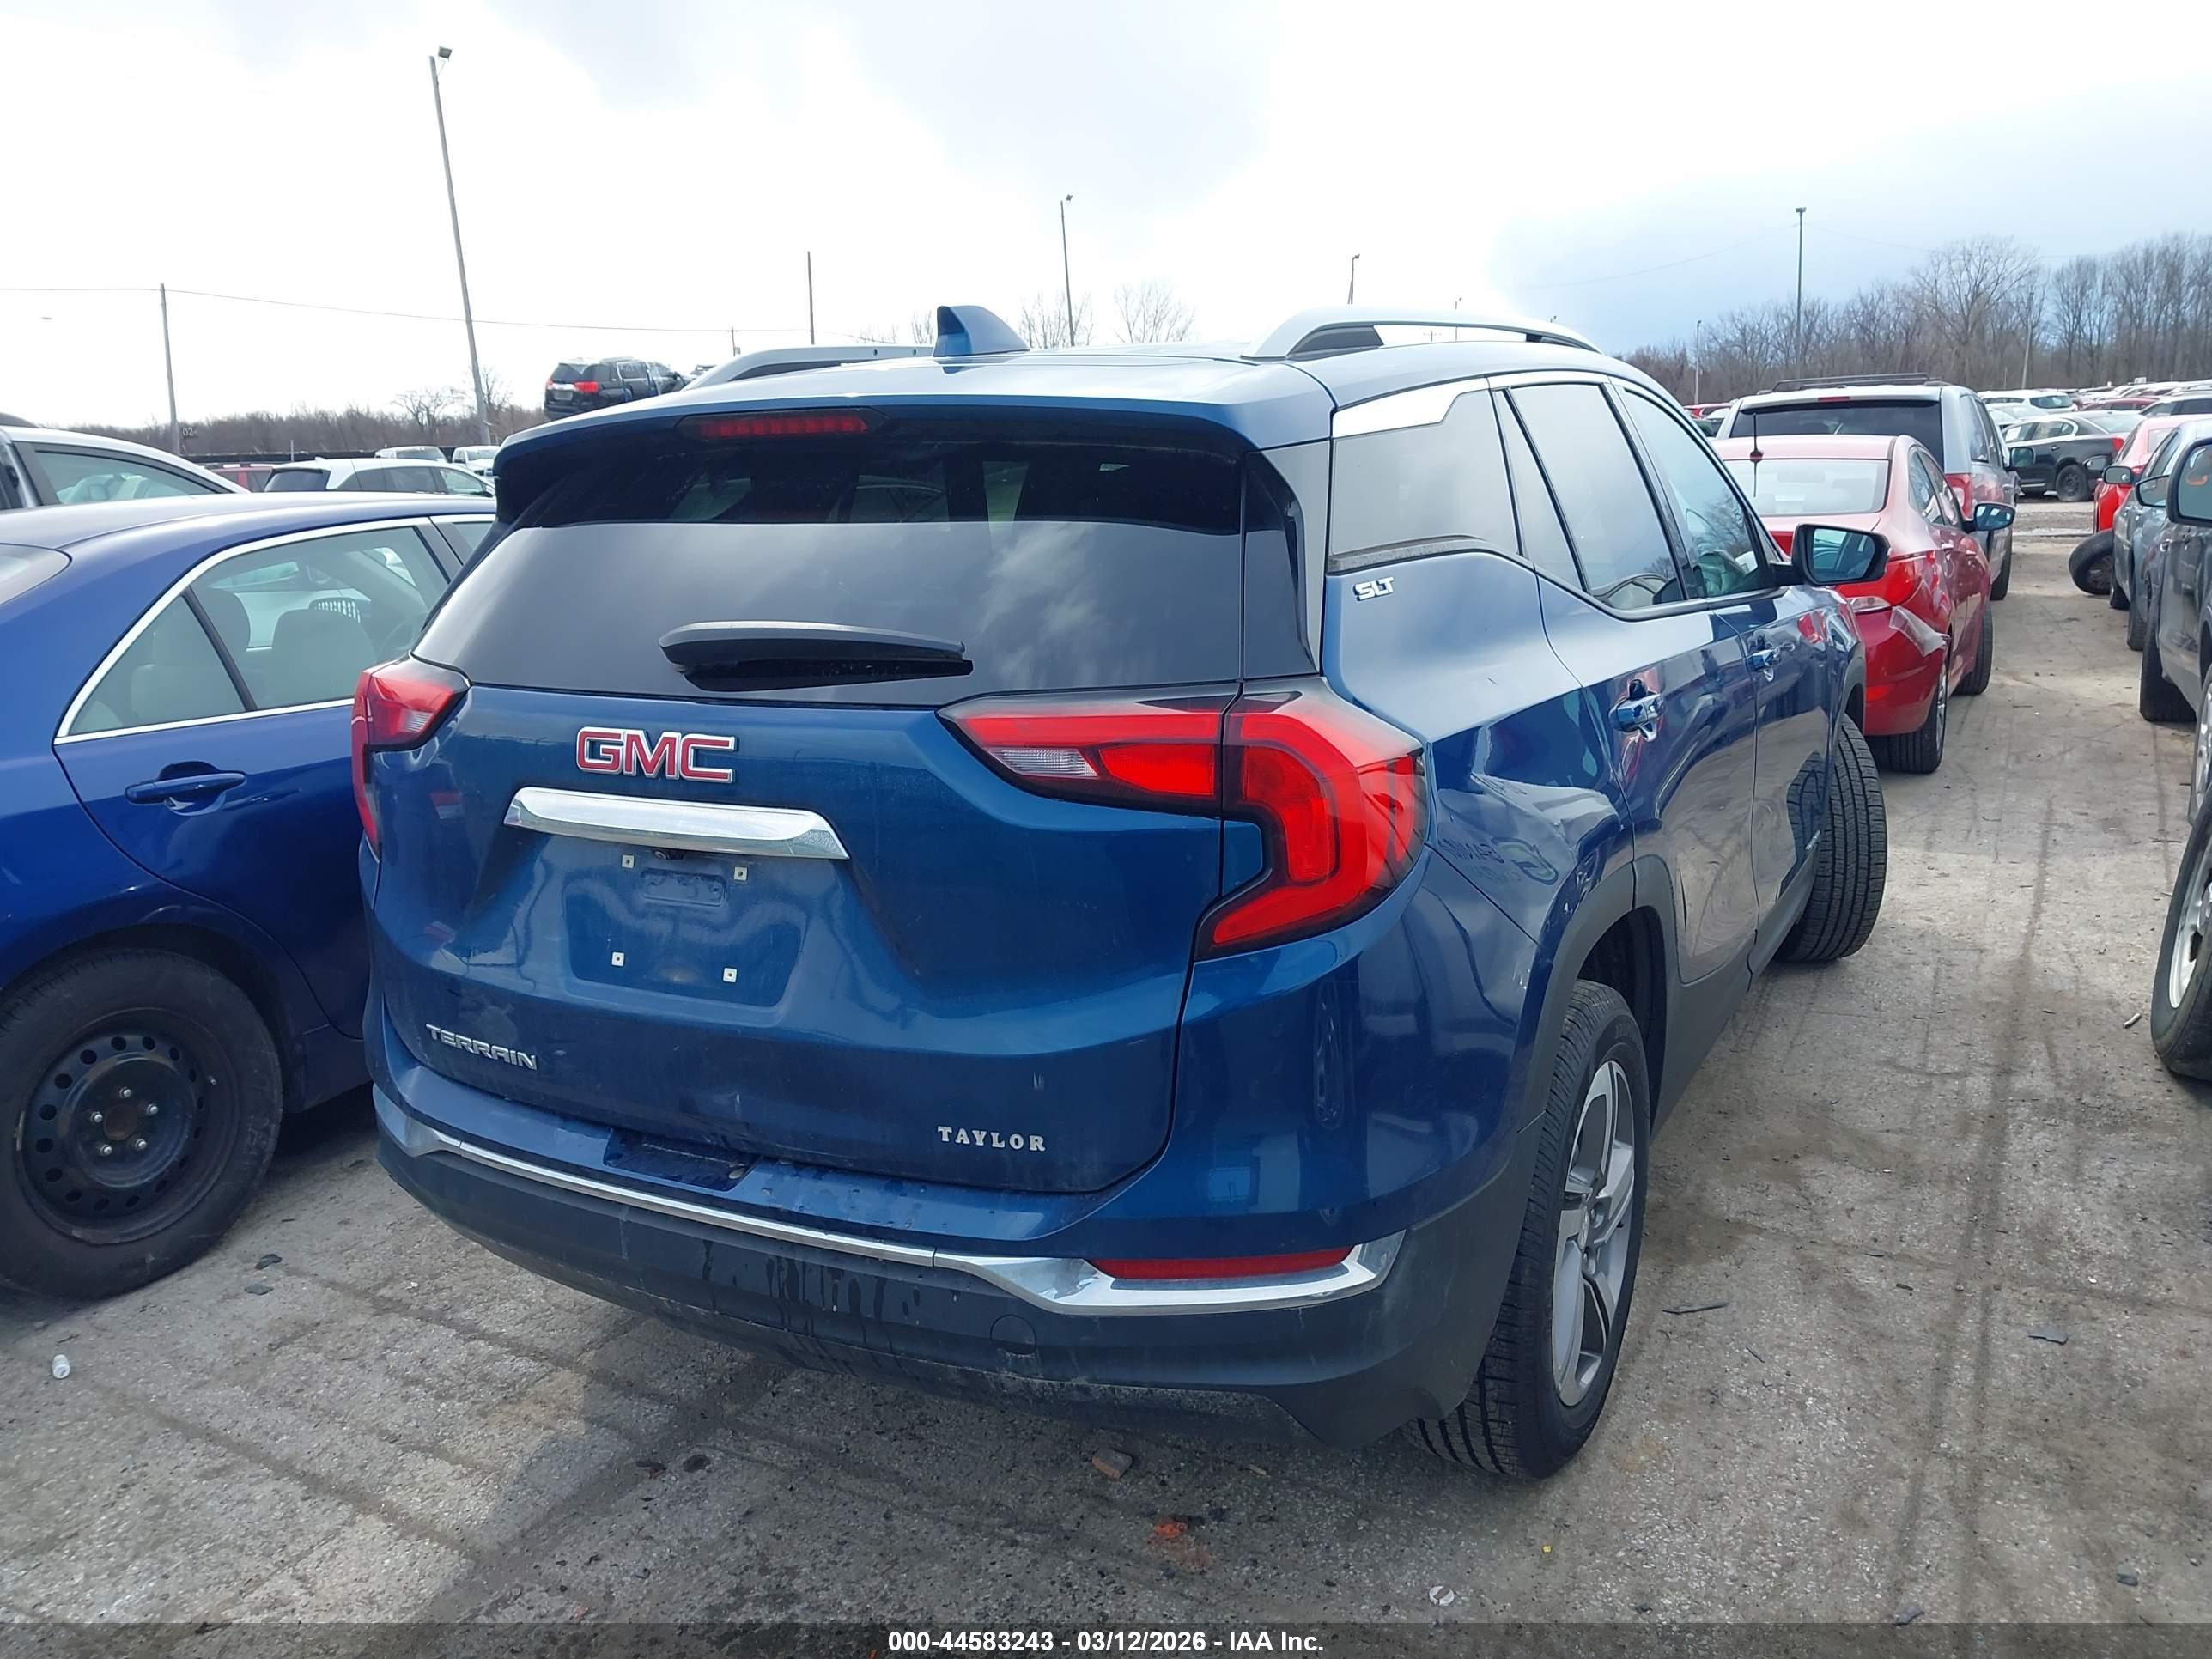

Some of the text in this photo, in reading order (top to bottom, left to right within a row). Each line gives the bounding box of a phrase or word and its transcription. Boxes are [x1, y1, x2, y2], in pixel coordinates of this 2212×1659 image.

[1353, 576, 1395, 601] SLT
[576, 726, 736, 784] GMC
[425, 1023, 538, 1071] TERRAIN
[937, 1125, 1046, 1152] TAYLOR
